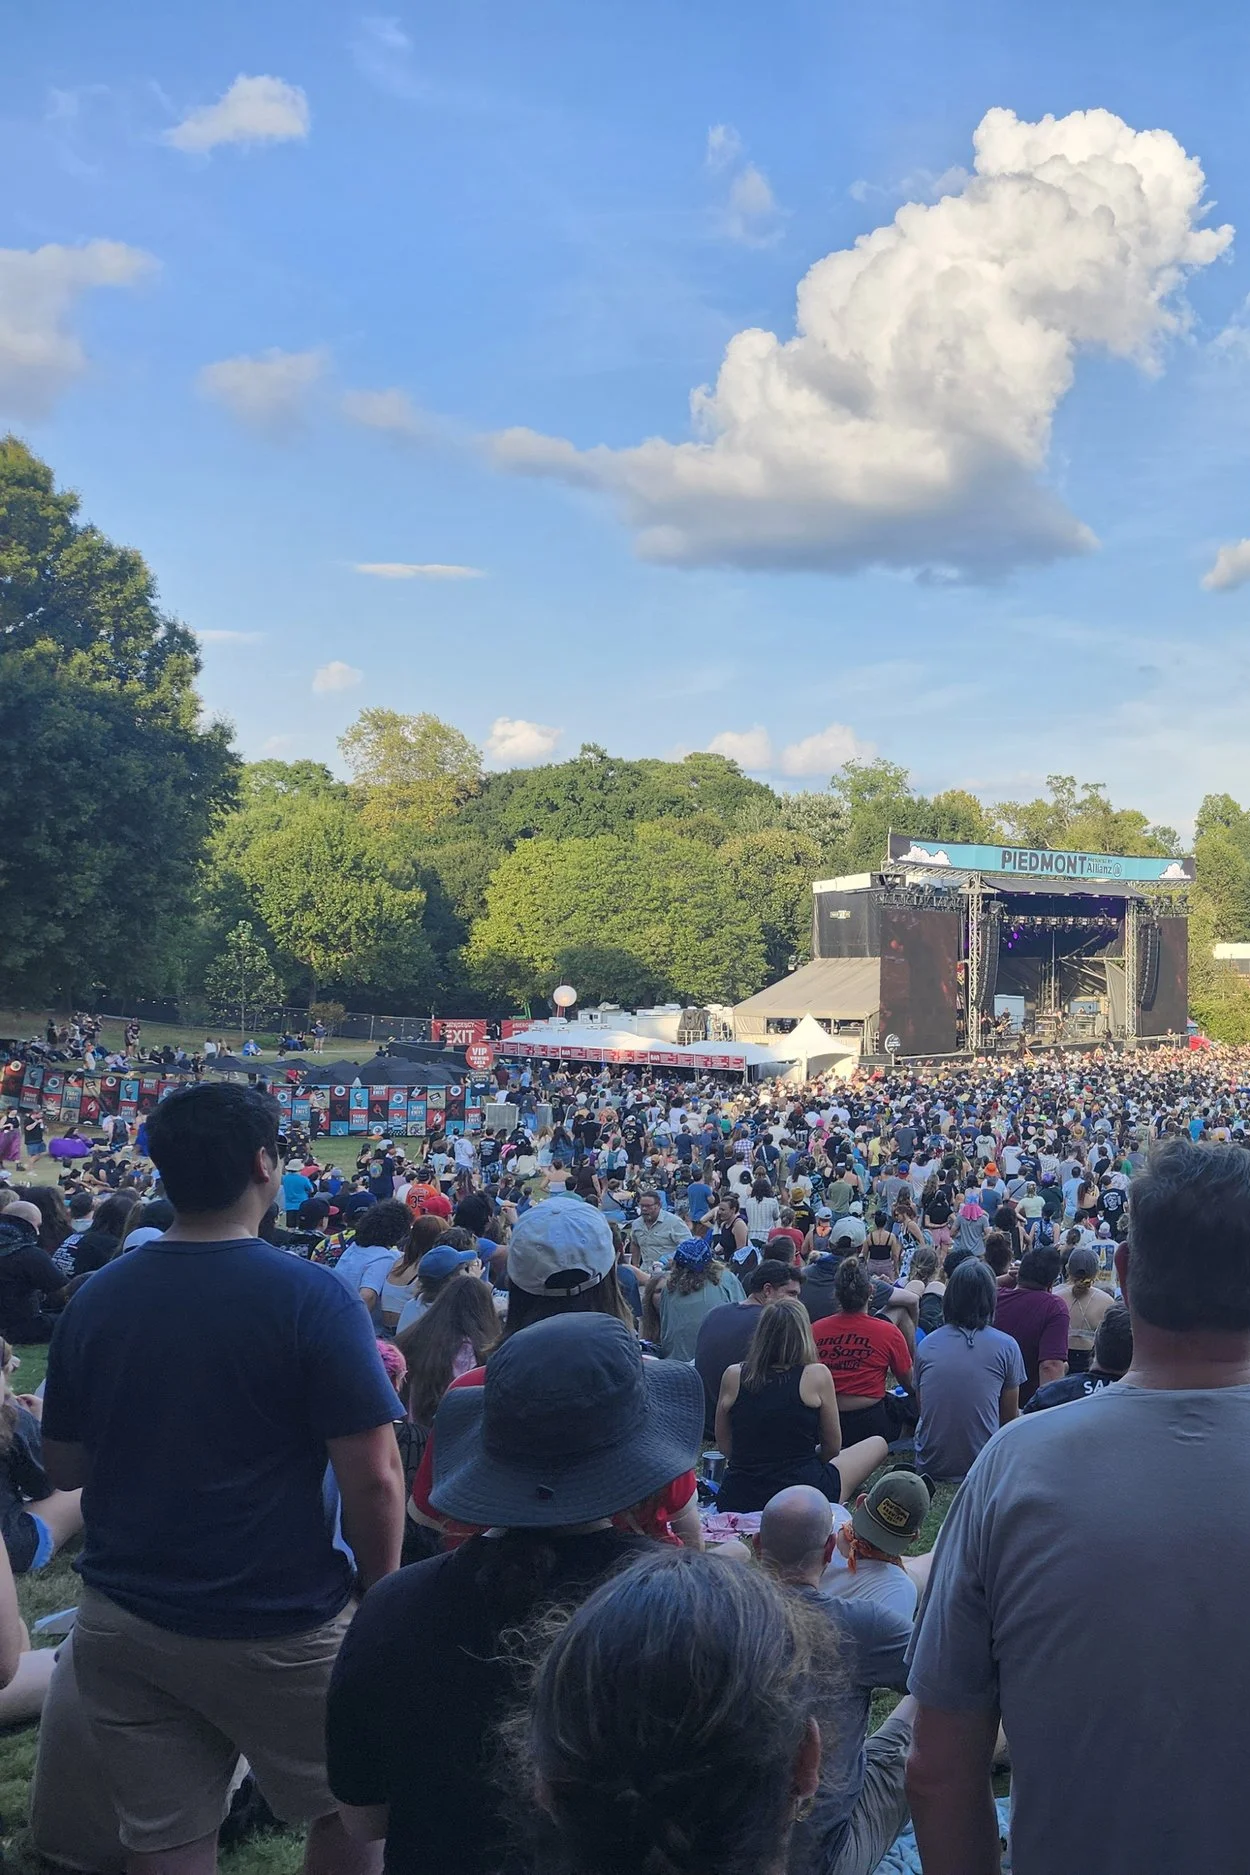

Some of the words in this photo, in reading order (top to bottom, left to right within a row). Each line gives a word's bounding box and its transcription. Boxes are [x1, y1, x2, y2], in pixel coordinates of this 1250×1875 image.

[1002, 850, 1087, 875] PIEDMONT
[1087, 863, 1112, 874] Allianz
[446, 1030, 474, 1044] EXIT
[472, 1047, 487, 1055] VIP
[845, 1333, 871, 1348] I'm
[819, 1349, 828, 1358] o
[829, 1346, 874, 1360] Sorry
